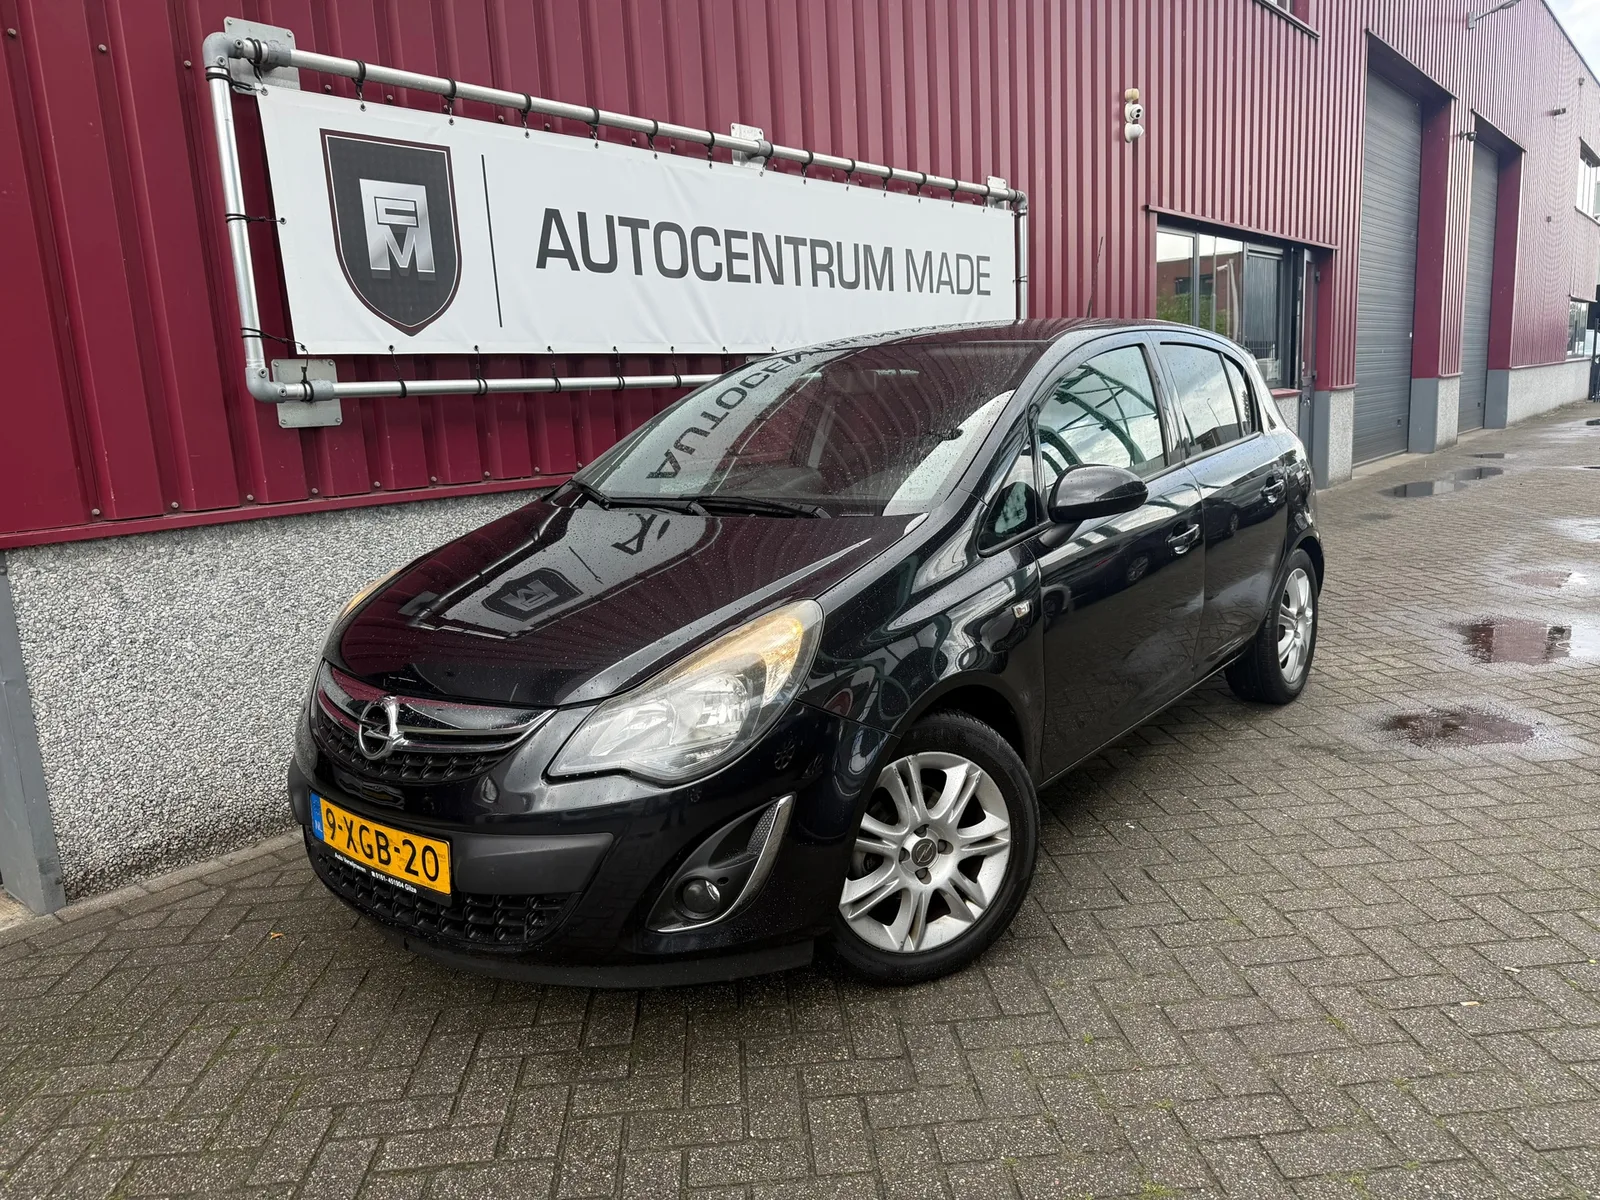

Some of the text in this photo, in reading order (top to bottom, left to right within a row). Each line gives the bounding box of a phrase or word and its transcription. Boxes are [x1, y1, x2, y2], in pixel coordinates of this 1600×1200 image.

[536, 207, 991, 296] AUTOCENTRUM MADE
[325, 807, 440, 882] 9-XGB-20
